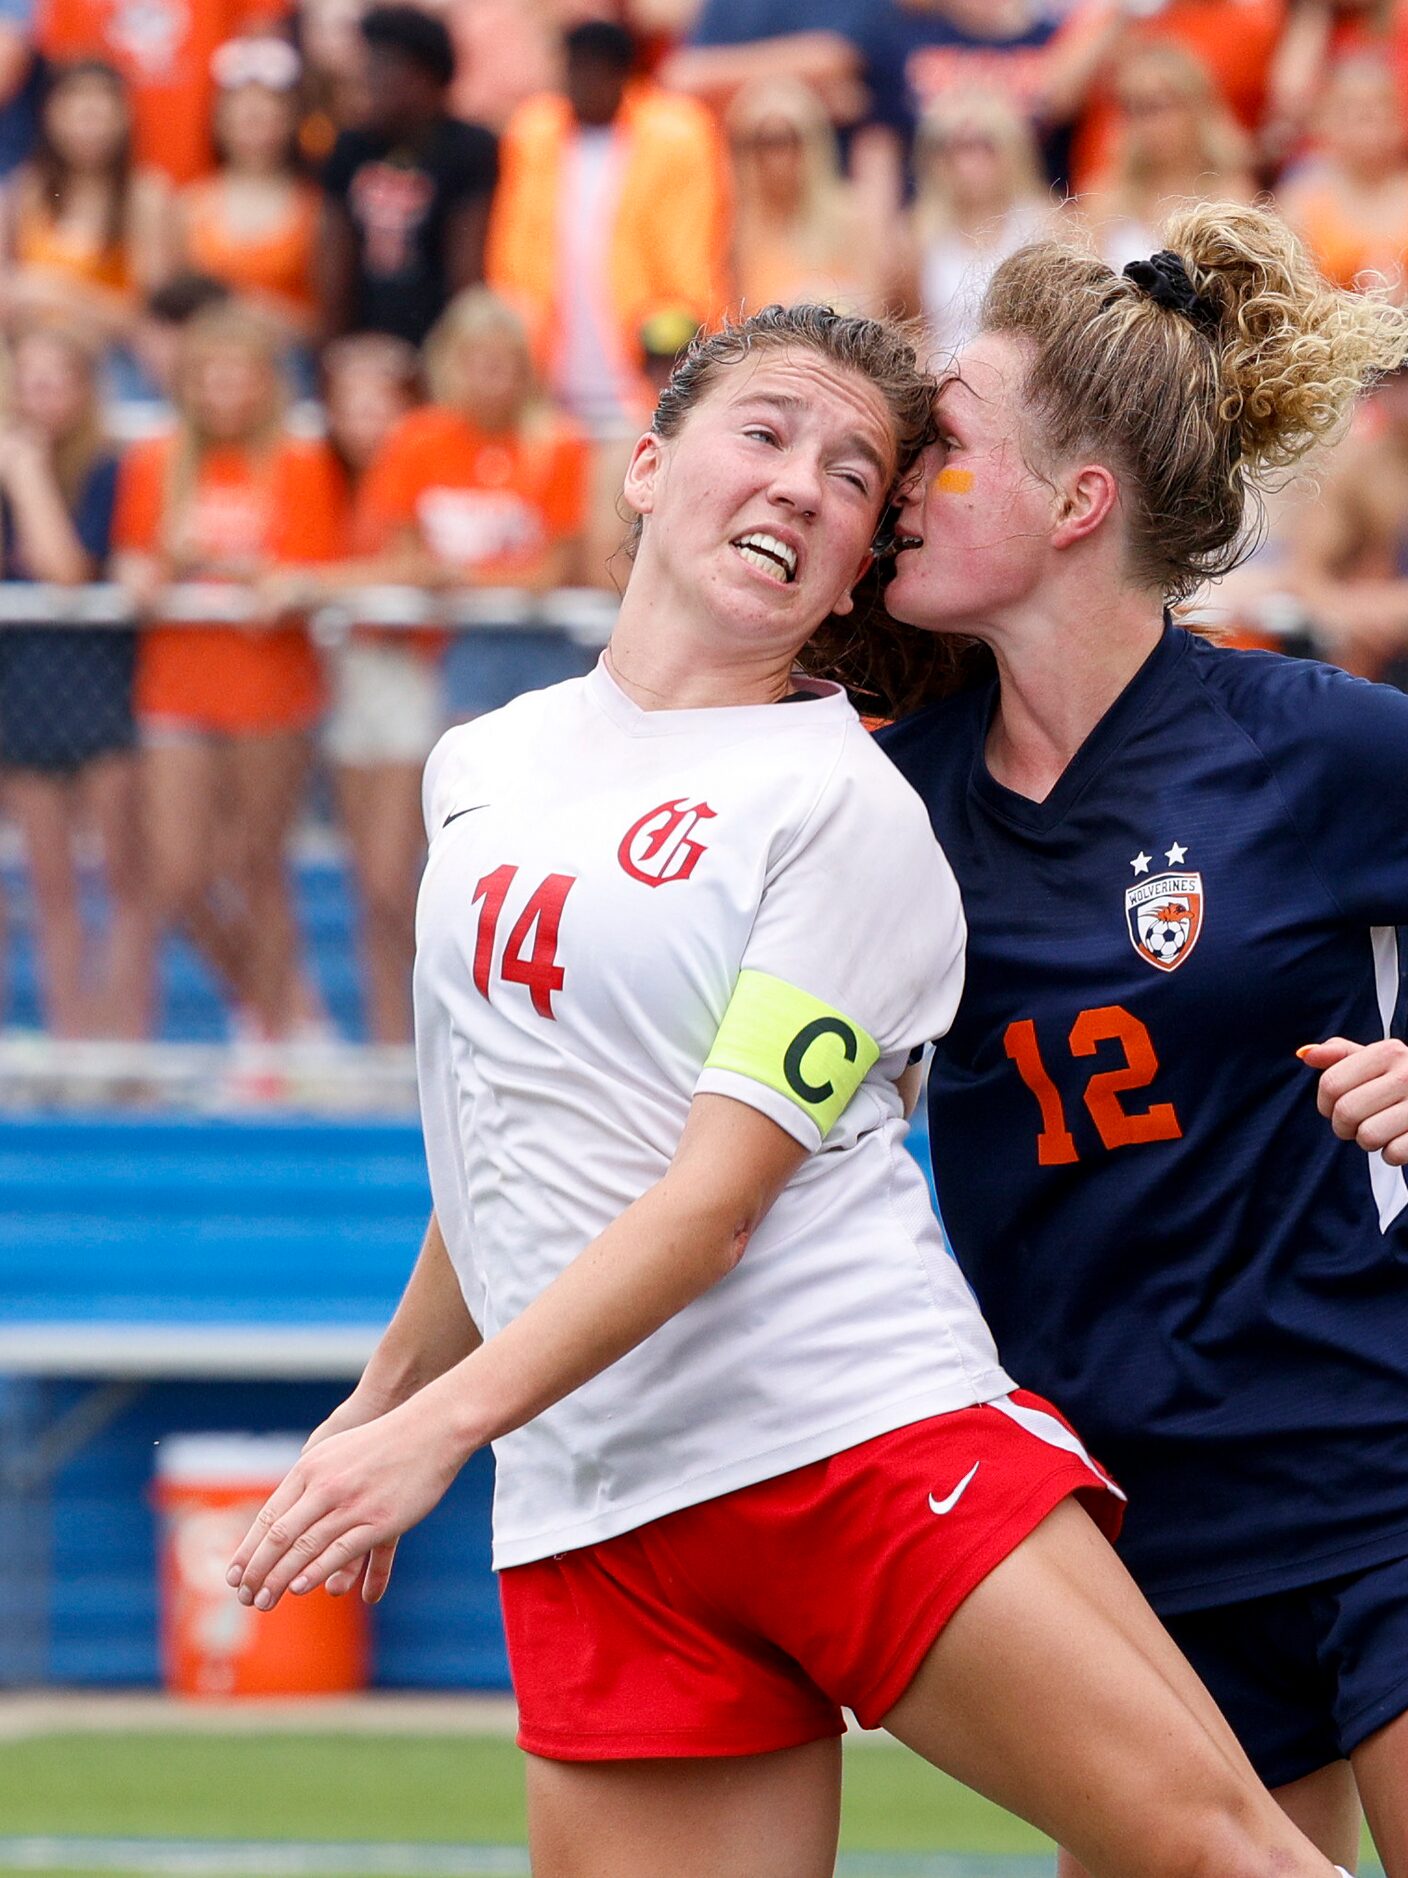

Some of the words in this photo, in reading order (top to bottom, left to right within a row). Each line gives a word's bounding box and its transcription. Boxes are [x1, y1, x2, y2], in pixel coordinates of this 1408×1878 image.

[472, 863, 577, 1021] 14
[1129, 879, 1196, 906] WOLVERINES
[783, 1016, 858, 1104] C
[1003, 1005, 1183, 1166] 12
